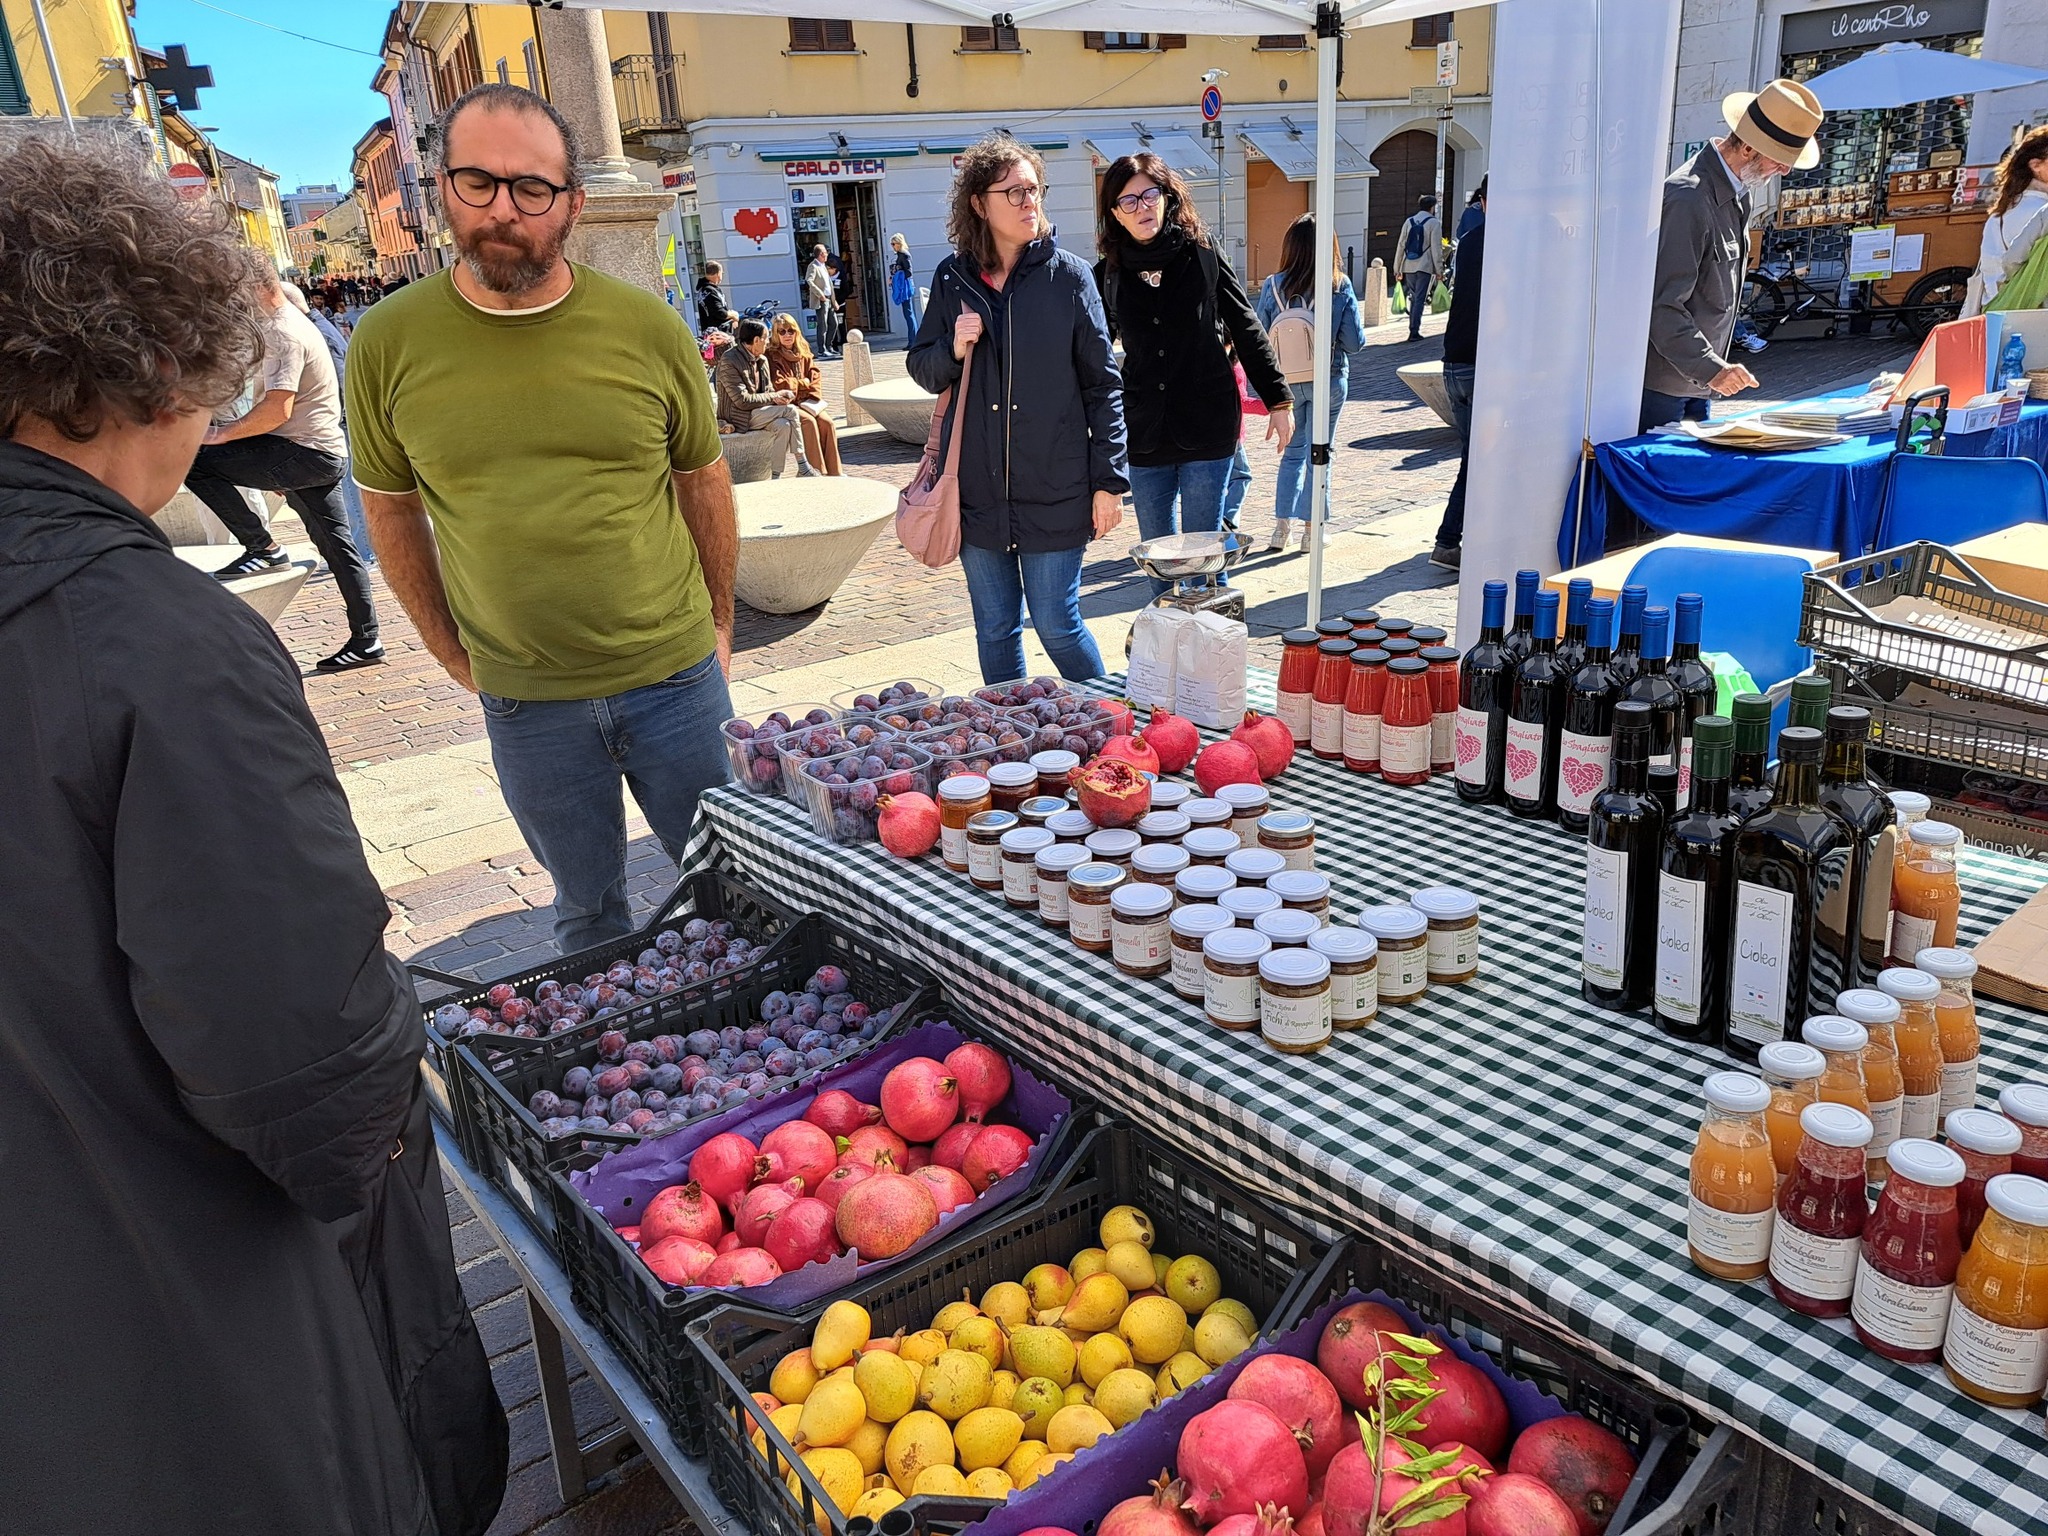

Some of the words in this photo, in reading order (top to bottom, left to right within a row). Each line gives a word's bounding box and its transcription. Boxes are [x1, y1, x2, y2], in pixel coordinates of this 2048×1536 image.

[785, 161, 840, 176] CARLO
[841, 159, 885, 175] TECH
[1567, 739, 1610, 757] Sbagliato
[1587, 894, 1614, 921] Ciolea
[1660, 925, 1689, 952] Ciolea
[1740, 939, 1777, 967] Ciolea
[1264, 1009, 1284, 1026] Fichi
[1780, 1235, 1826, 1263] Mirabolano
[1873, 1286, 1928, 1313] Mirabolano
[1961, 1324, 2017, 1355] Mirabolano
